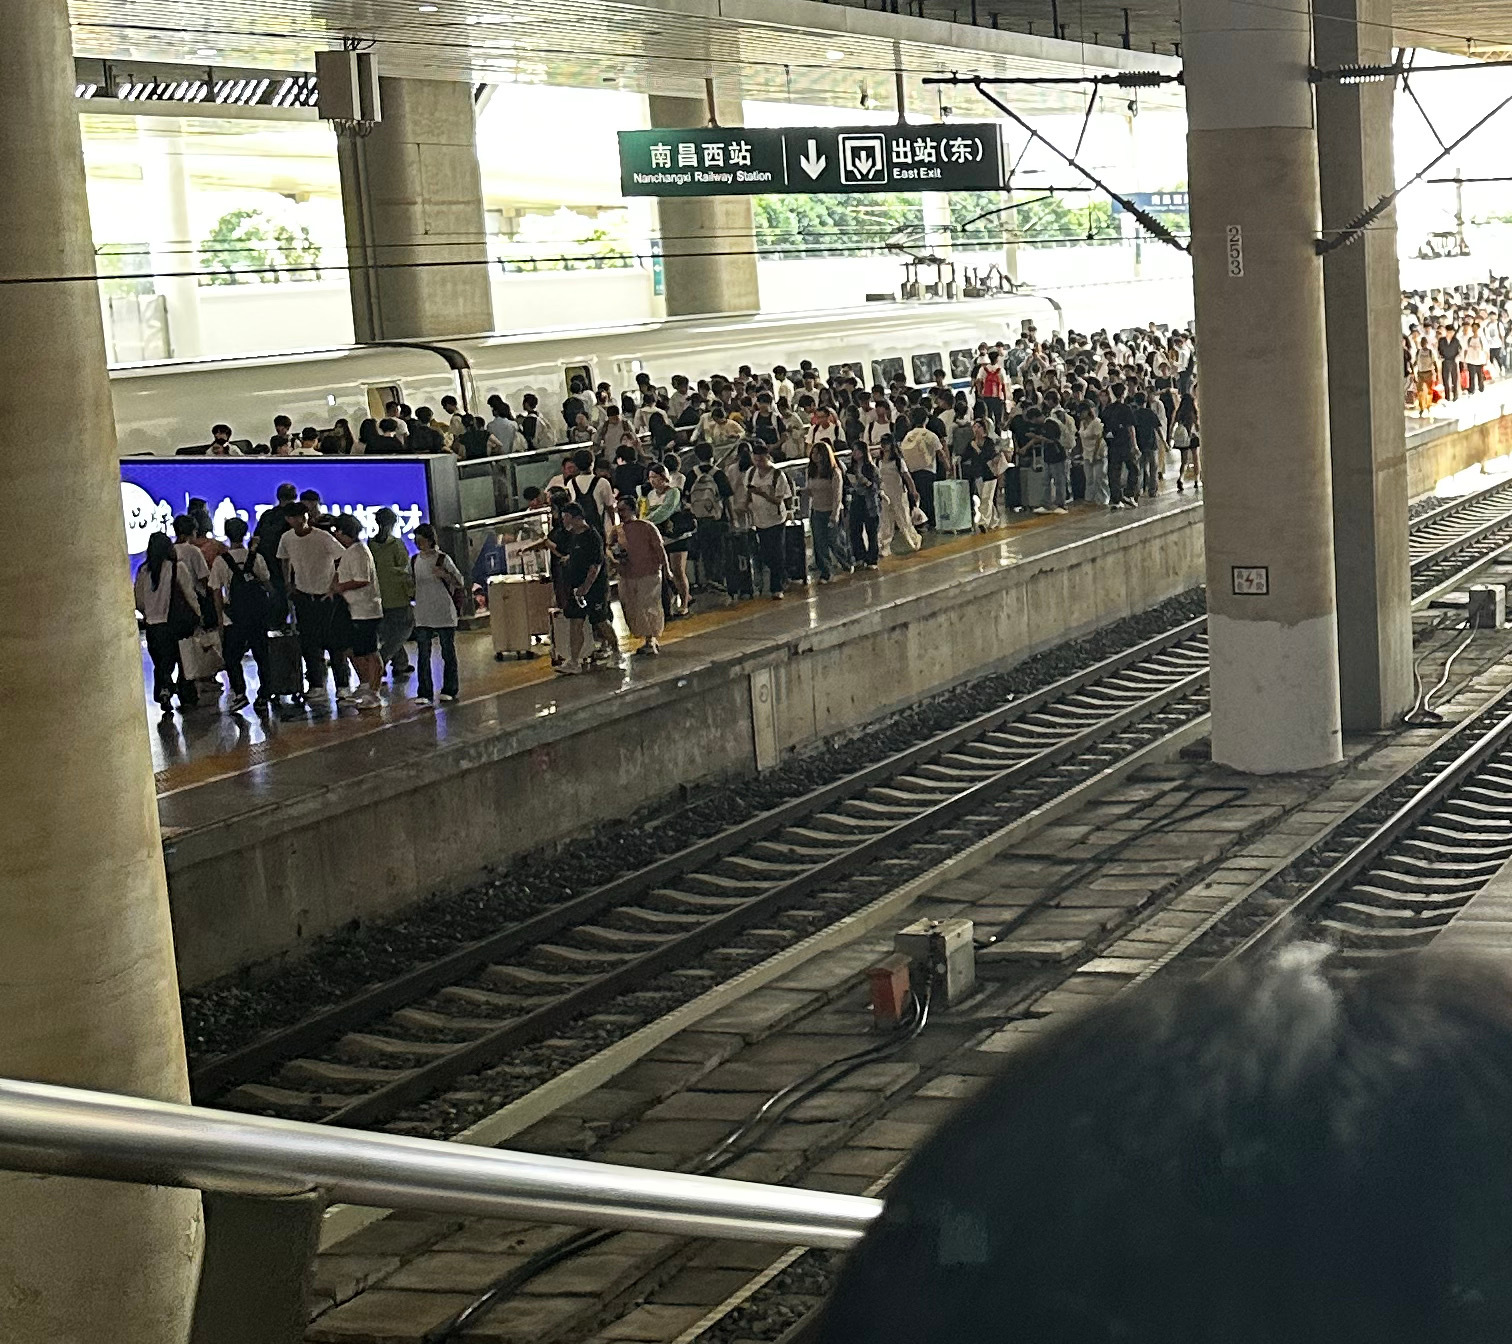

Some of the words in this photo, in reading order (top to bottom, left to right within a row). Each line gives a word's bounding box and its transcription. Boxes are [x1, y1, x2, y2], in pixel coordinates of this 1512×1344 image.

[649, 140, 752, 168] 南昌西站
[694, 171, 733, 184] Railway
[736, 170, 772, 182] Station
[892, 167, 919, 179] East
[919, 167, 942, 179] Exit
[1229, 226, 1241, 276] 253
